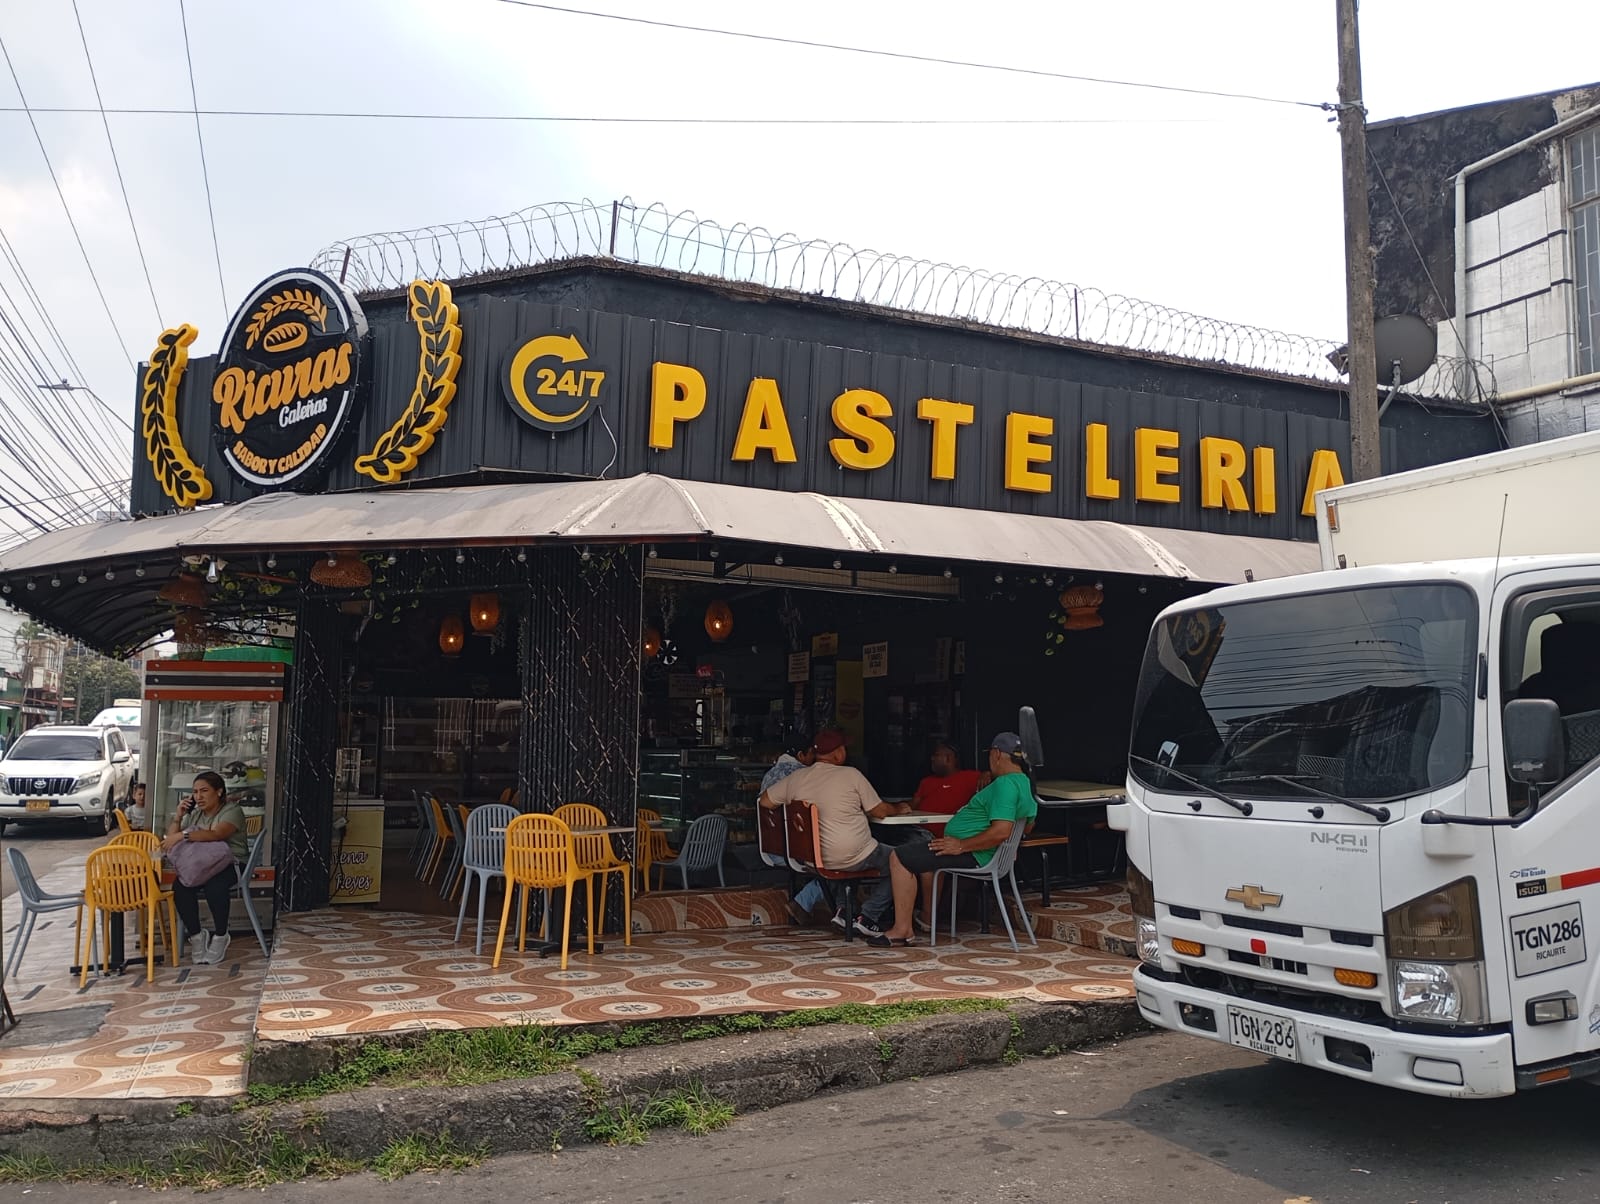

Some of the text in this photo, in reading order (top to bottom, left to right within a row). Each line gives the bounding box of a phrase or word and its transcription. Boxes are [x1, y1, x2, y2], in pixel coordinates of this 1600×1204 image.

[213, 342, 353, 434] Ricuras
[536, 368, 605, 397] 24/7
[279, 397, 328, 427] Caleñas
[232, 423, 327, 475] SABOR Y CALIDAD
[648, 360, 1345, 516] PASTELERIA
[1310, 831, 1356, 846] NKR
[335, 872, 373, 896] Reyes
[1519, 885, 1546, 897] ISUZU
[1536, 945, 1567, 960] RICAURTE
[1230, 1012, 1294, 1049] TGN 286
